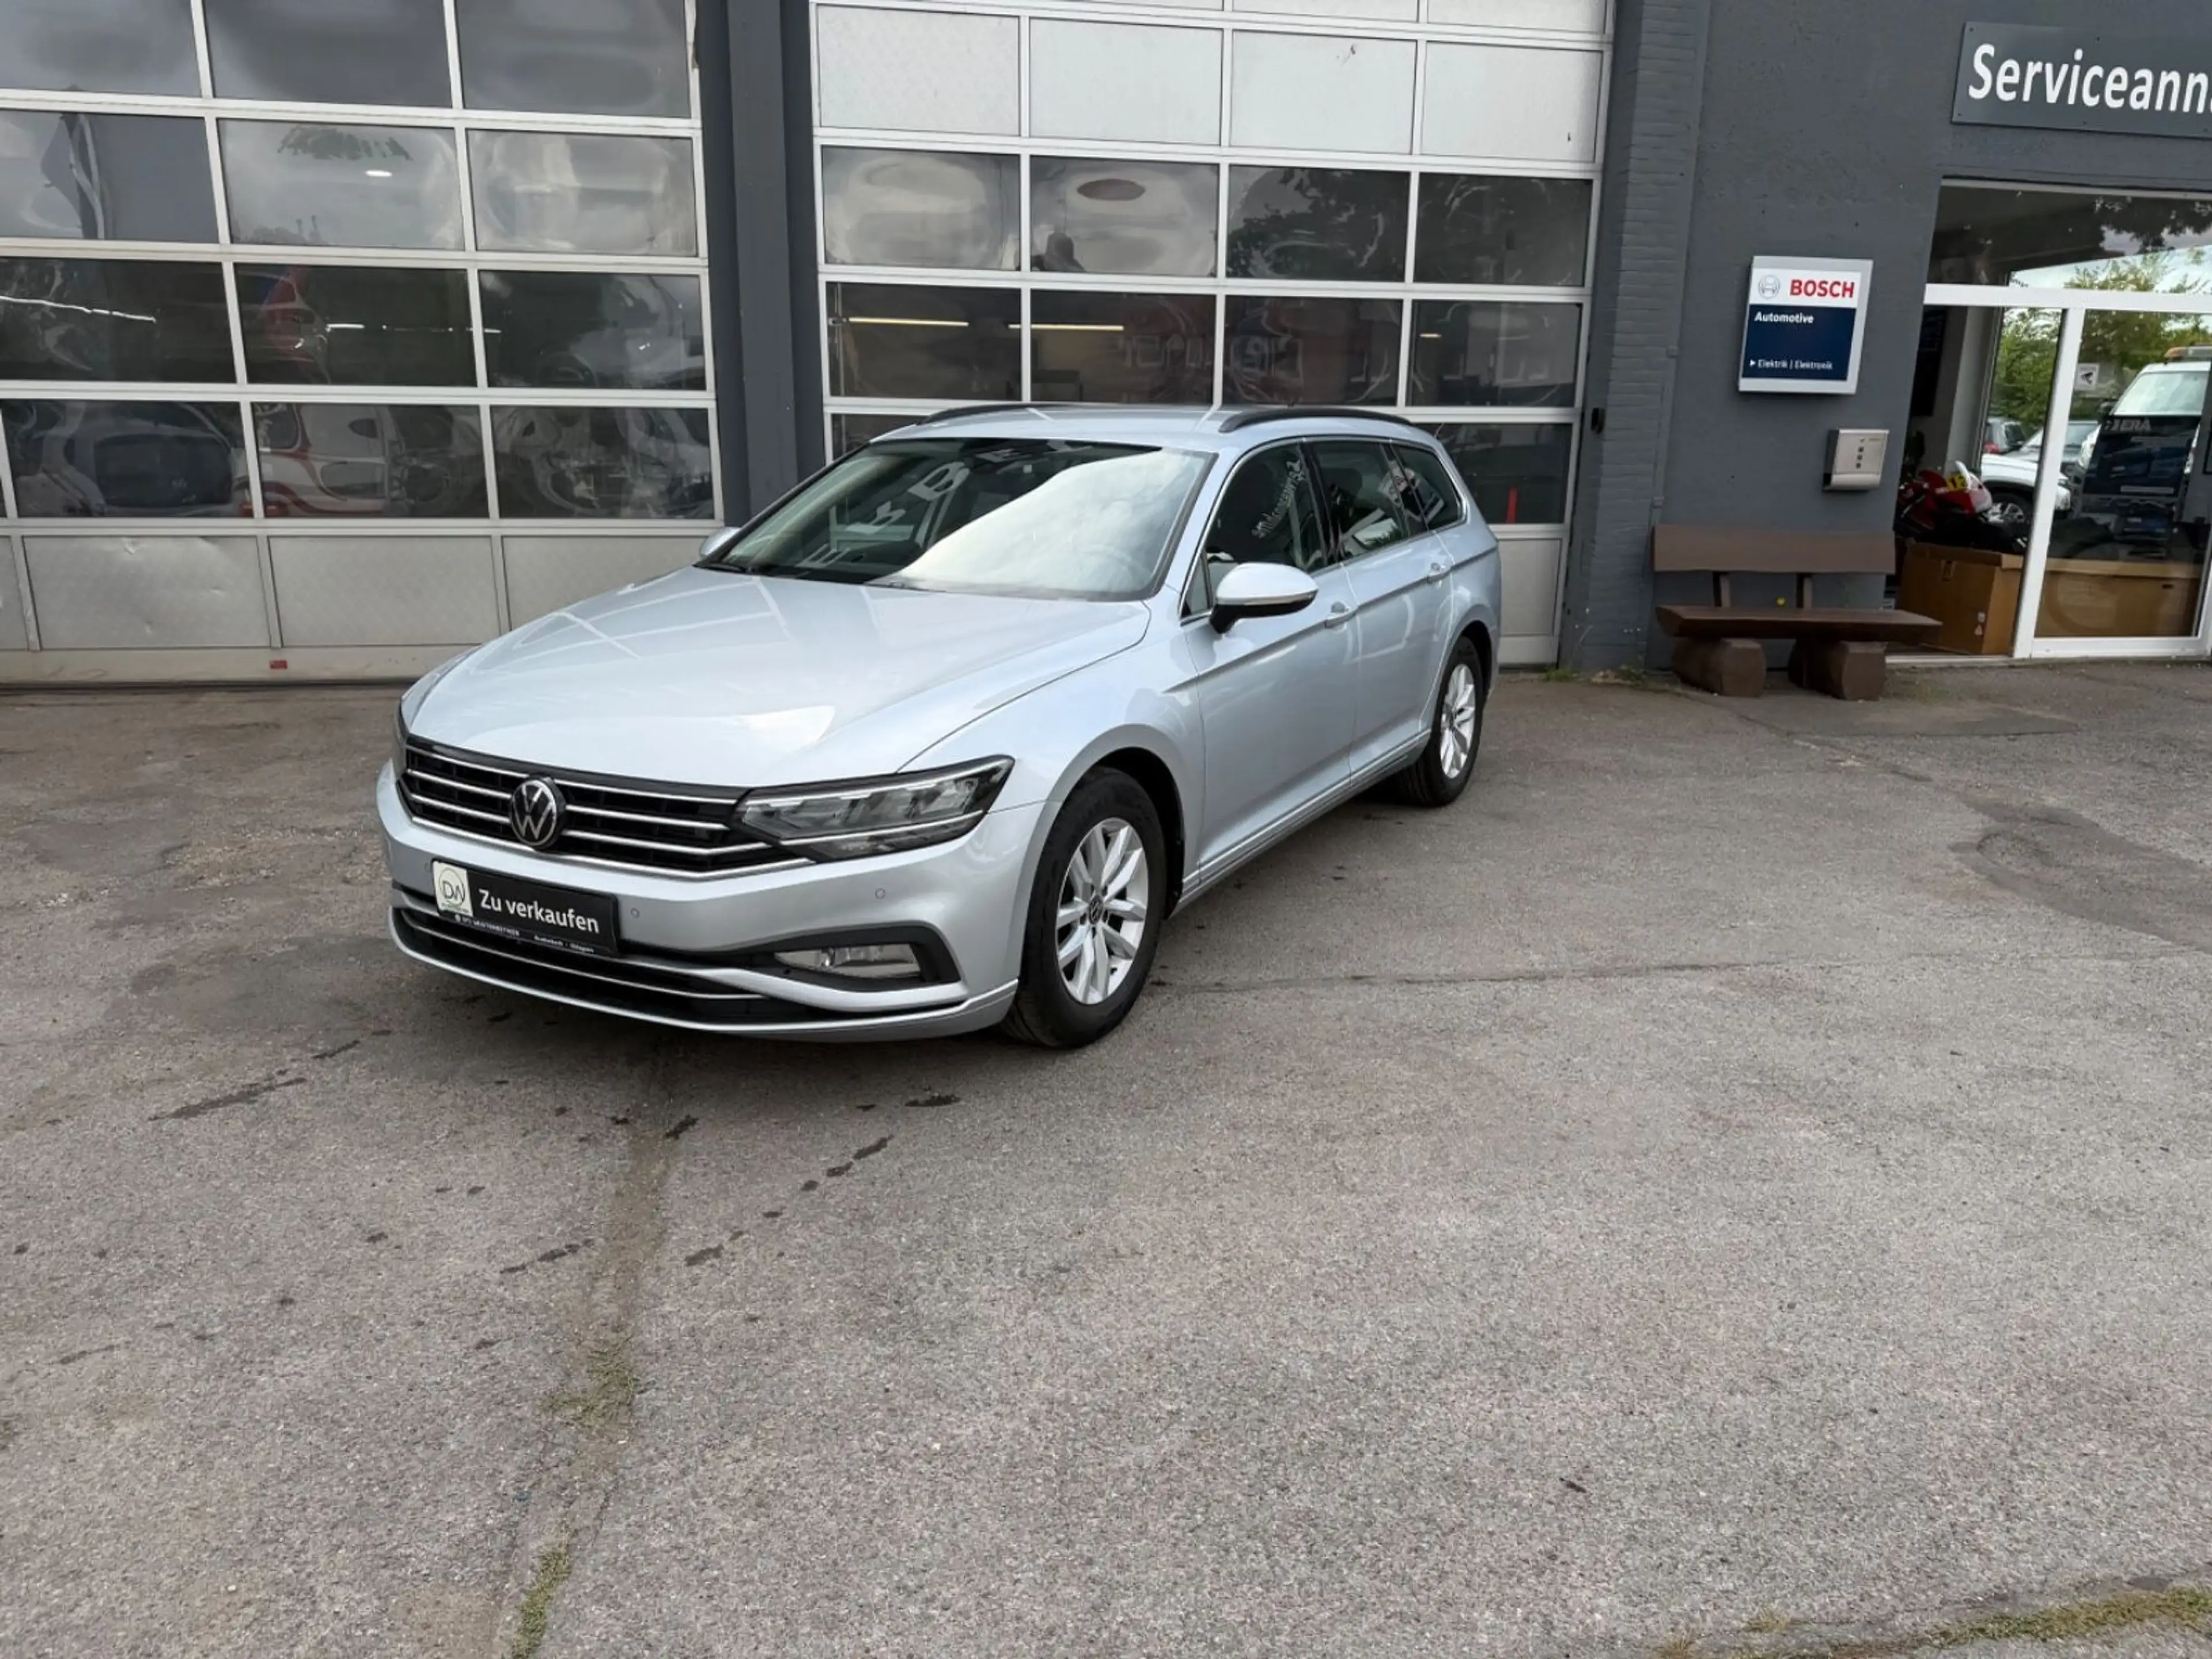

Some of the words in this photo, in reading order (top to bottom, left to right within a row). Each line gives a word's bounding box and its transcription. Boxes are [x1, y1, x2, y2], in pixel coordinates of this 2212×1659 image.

[1968, 43, 2212, 115] Serviceann
[1790, 279, 1855, 298] BOSCH
[1754, 312, 1815, 324] Automotive
[1758, 359, 1788, 369] Elektrik
[1794, 359, 1833, 370] Elektronik
[478, 888, 502, 912] Zu
[506, 899, 600, 934] verkaufen
